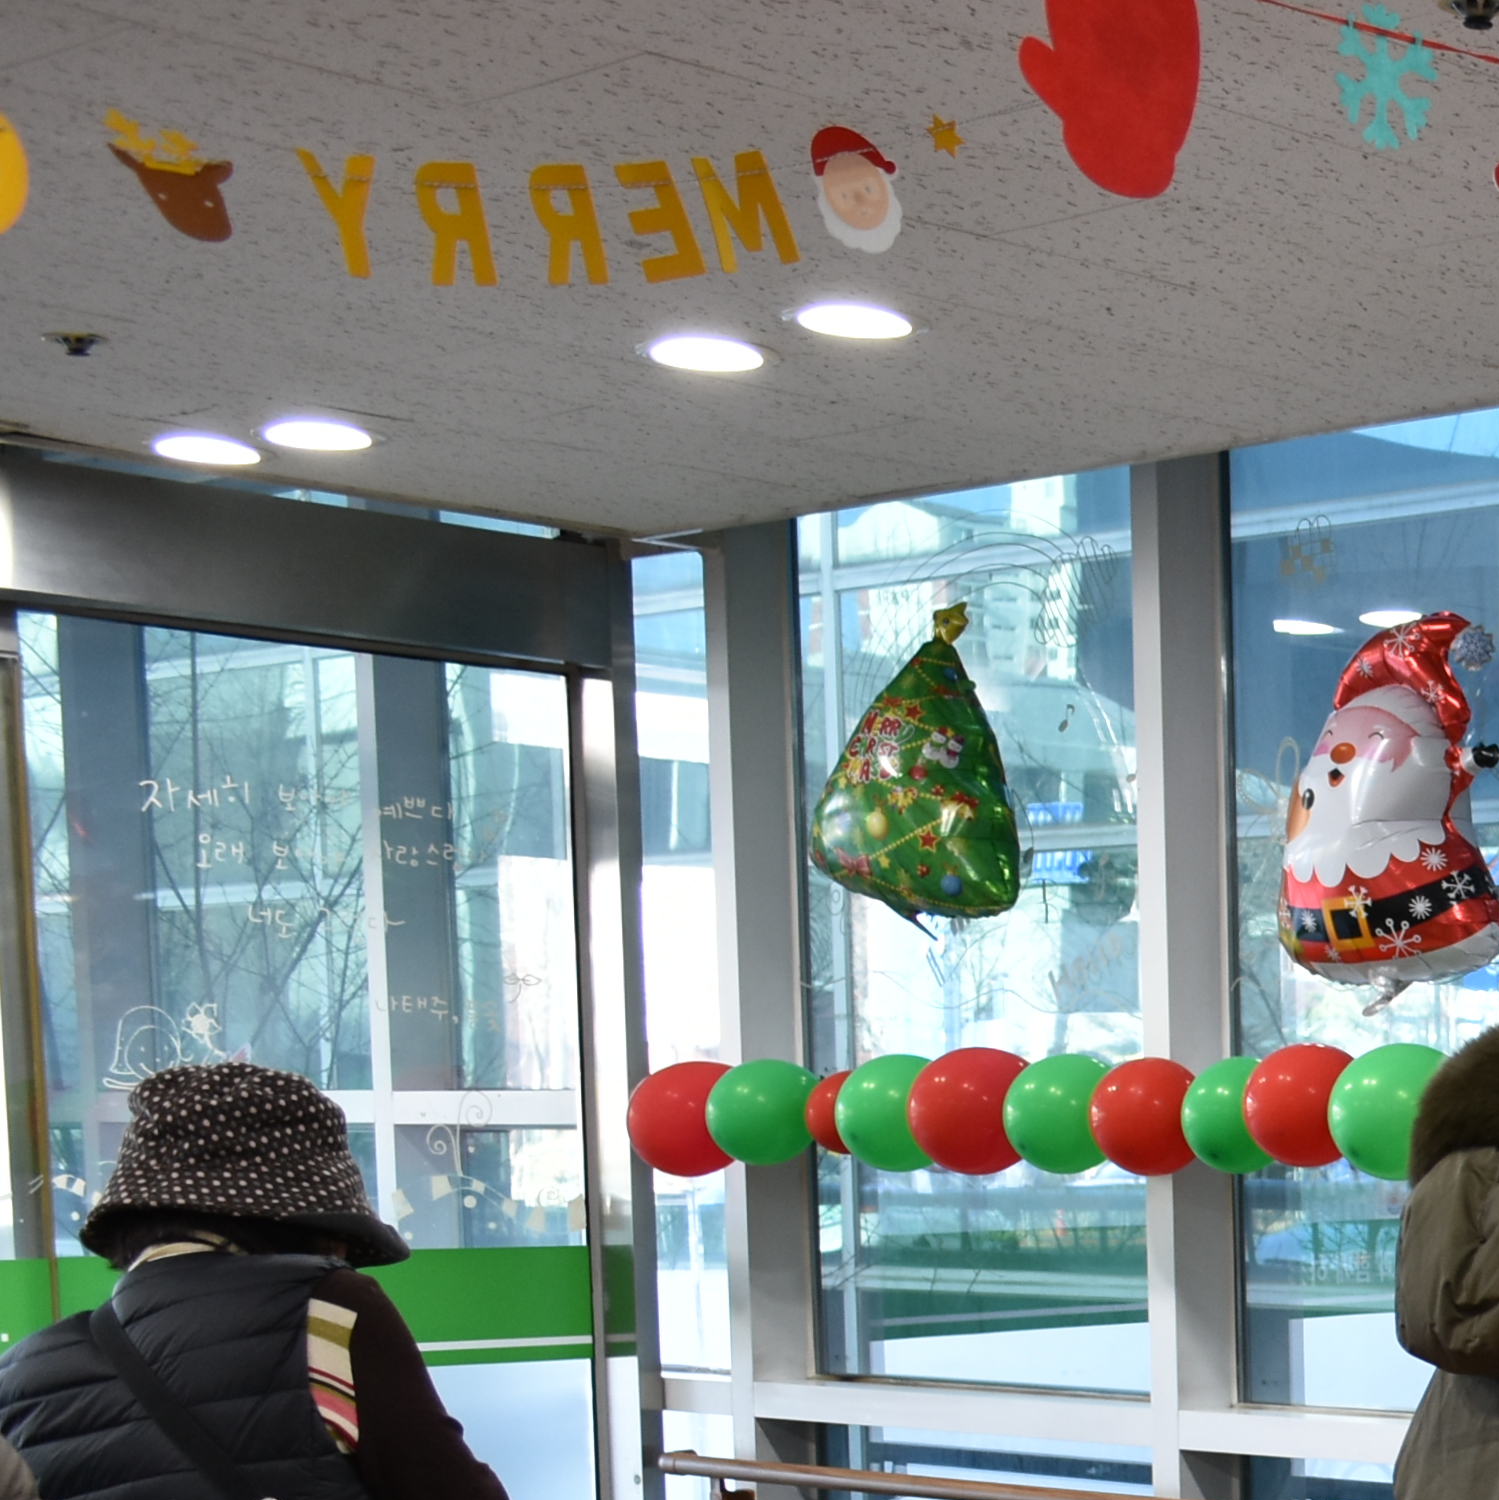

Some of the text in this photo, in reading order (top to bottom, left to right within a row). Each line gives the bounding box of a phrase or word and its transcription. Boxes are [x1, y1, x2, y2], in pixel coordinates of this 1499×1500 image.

[139, 775, 250, 812] 자세히
[196, 833, 246, 869] 오래
[248, 905, 296, 938] 너도
